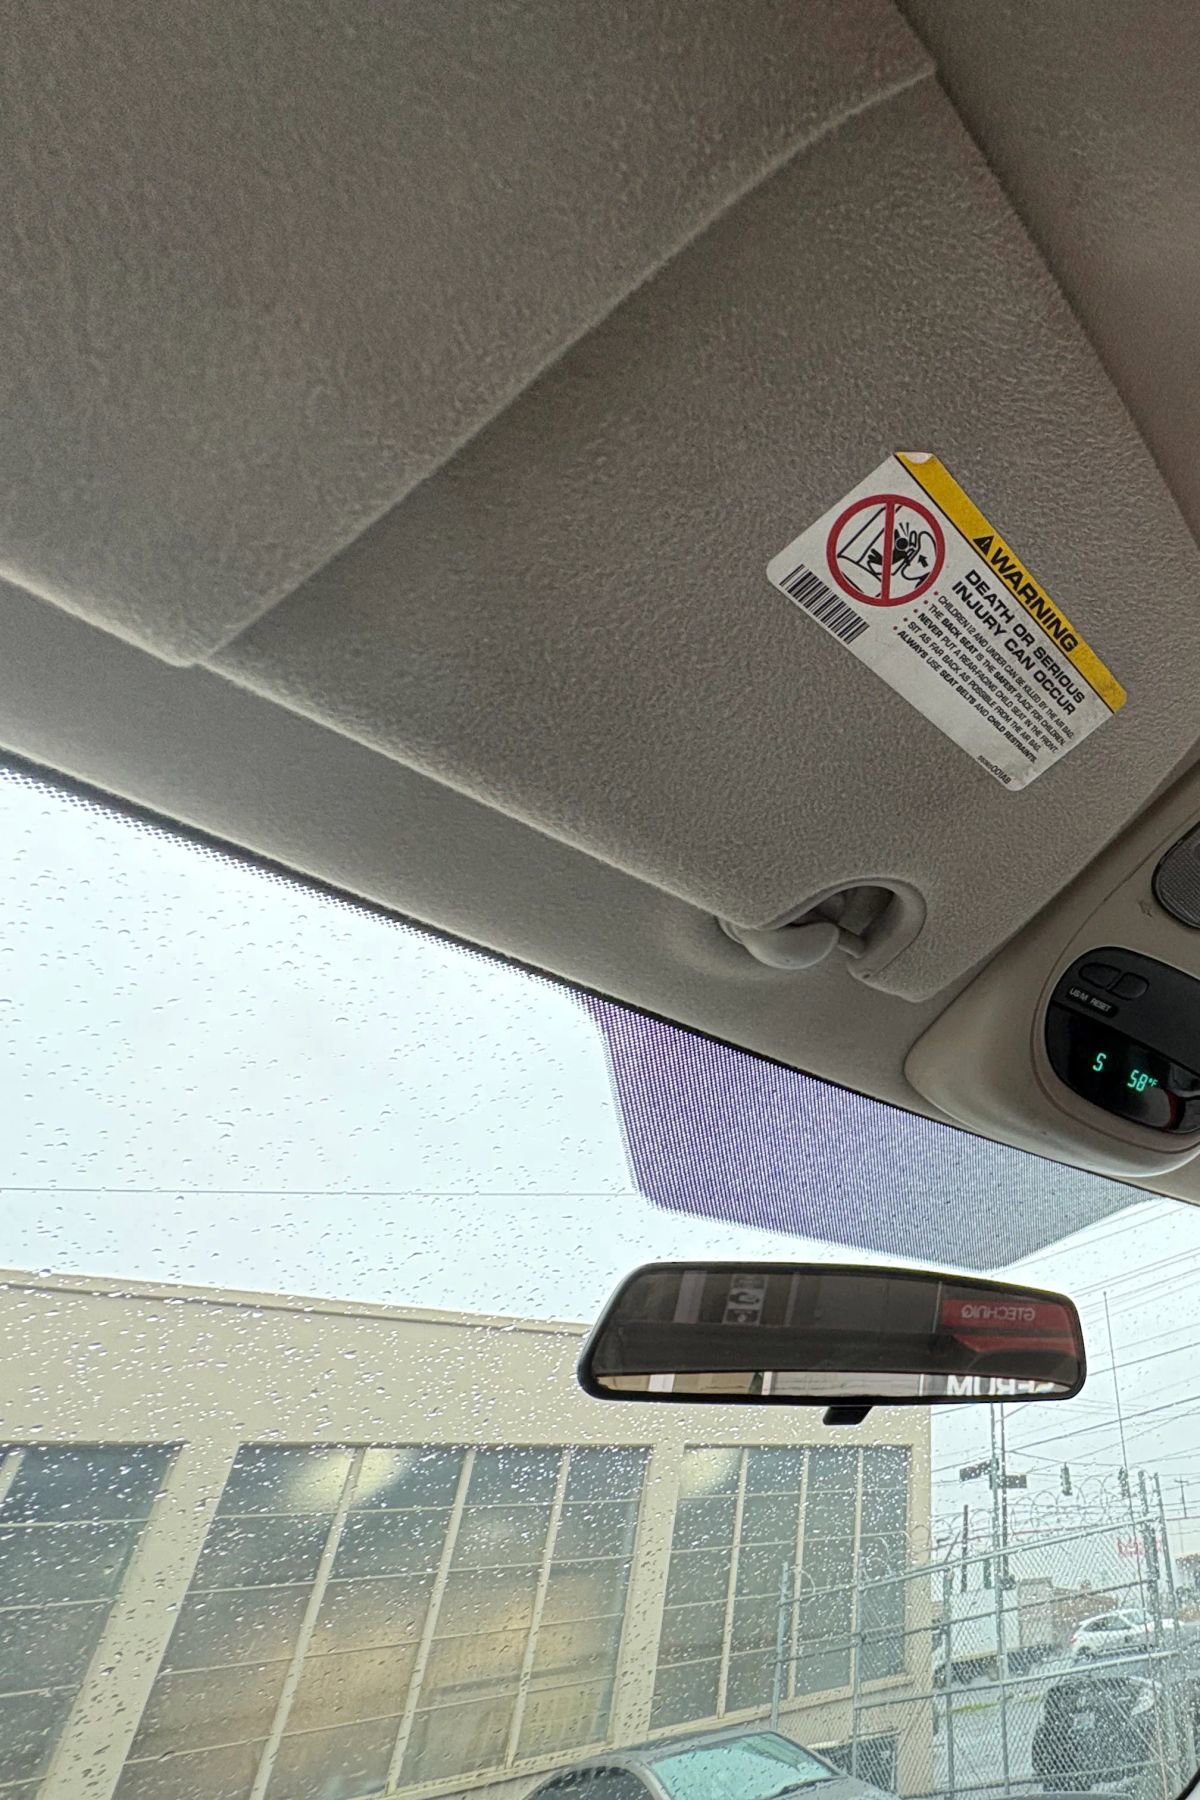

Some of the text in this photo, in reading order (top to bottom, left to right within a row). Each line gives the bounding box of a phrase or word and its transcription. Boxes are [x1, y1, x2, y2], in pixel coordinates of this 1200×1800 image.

[937, 595, 1074, 739] CHILDREN 12 AND UNDER CAN BE KILLED BY THE AIR BAG.
[951, 580, 1076, 715] INJURY CAN OCCUR
[964, 569, 1085, 703] DEATH OR SERIOUS
[987, 547, 1079, 653] WARNING
[897, 629, 1037, 763] ALWAYS USE SEAT BELTS AND CHILD RESTRAINTS.
[907, 621, 1041, 752] SIT AS FAR BACK AS POSSIBLE FROM THE AIR BAG.
[917, 612, 1058, 753] NEVER PUT A REAR-FACING CHILD SEAT IN THE FRONT.
[928, 604, 1066, 746] THE BACK SEAT IS THE SAFEST PLACE FOR CHILDREN.
[1090, 997, 1112, 1012] RESET
